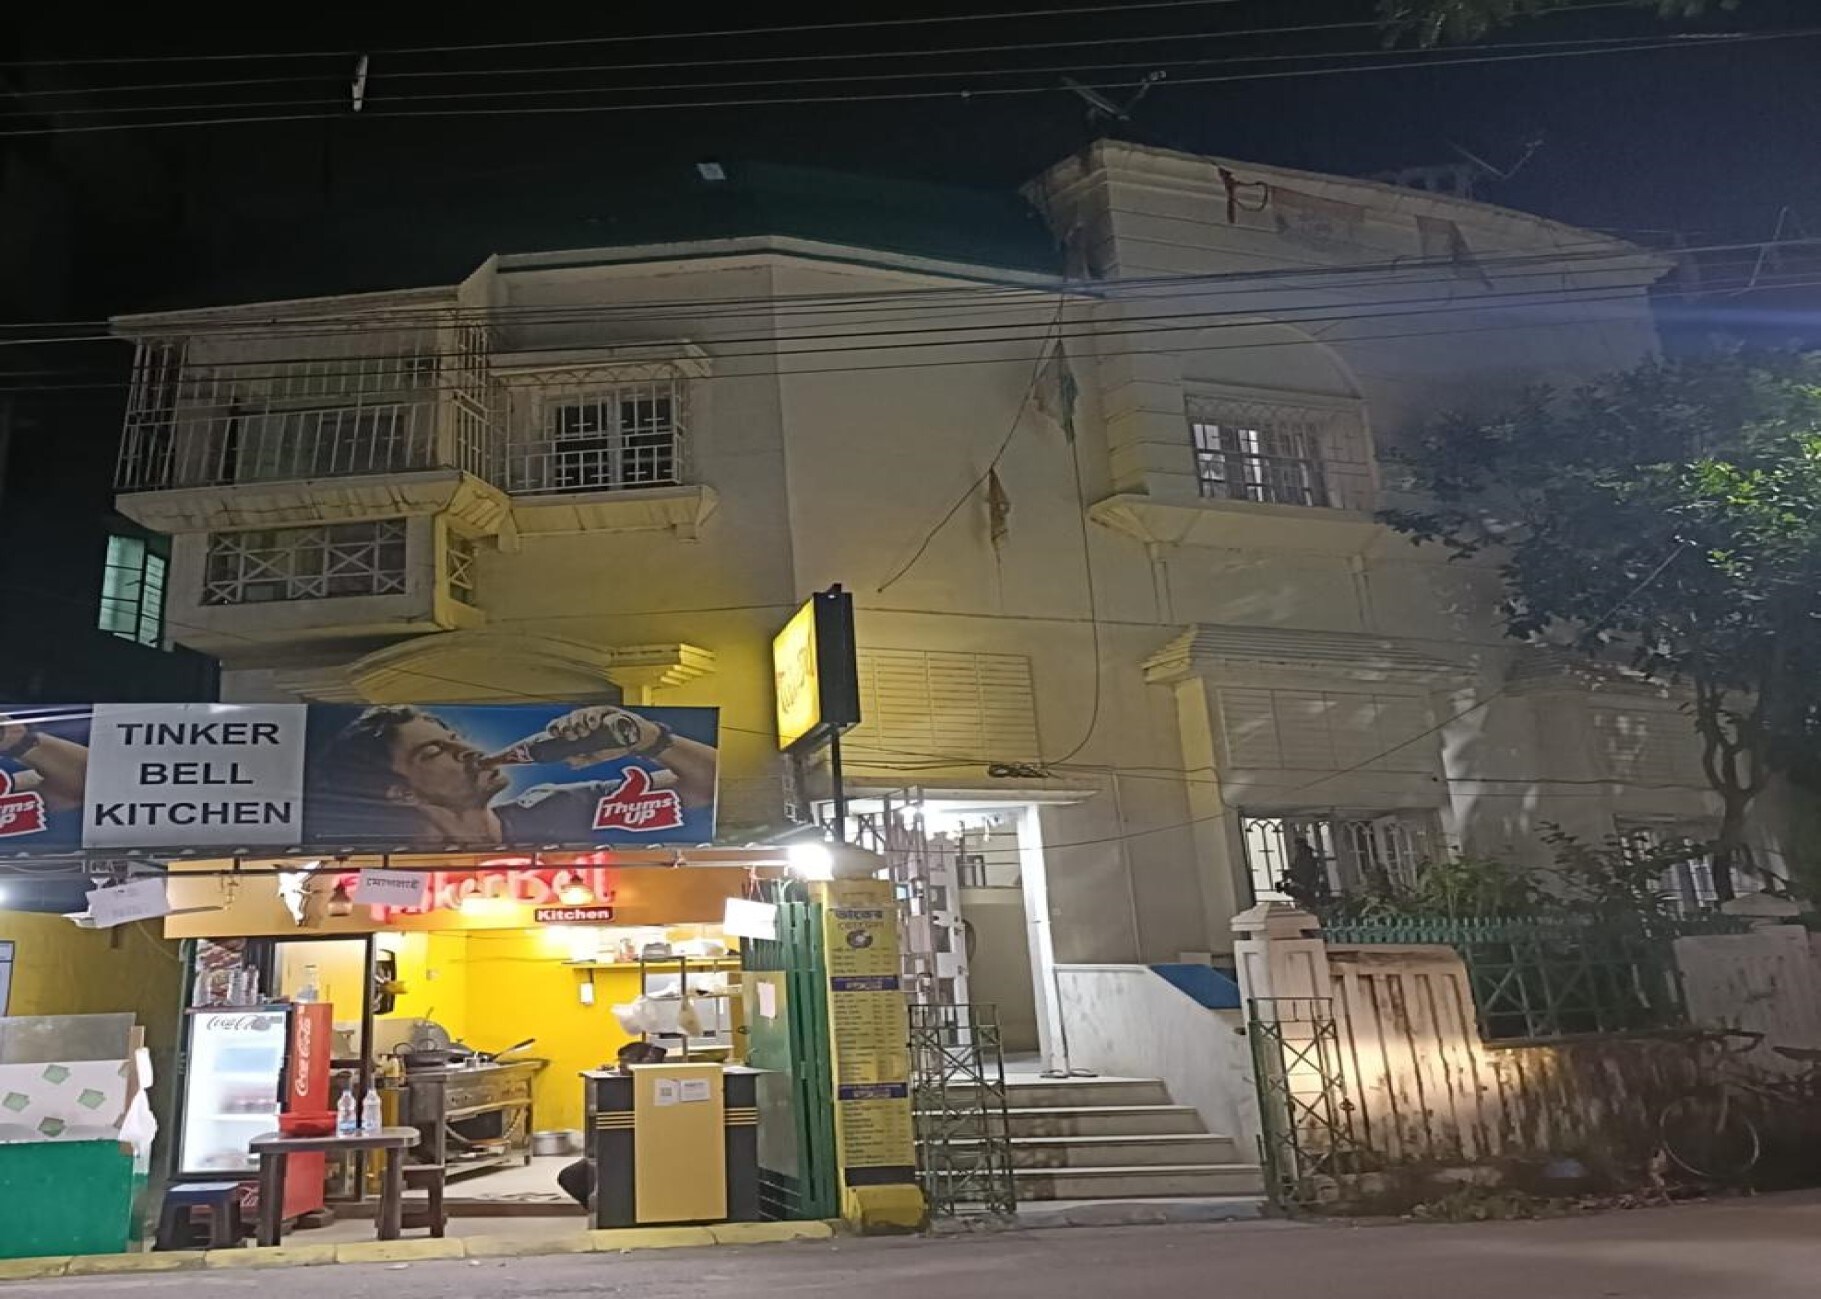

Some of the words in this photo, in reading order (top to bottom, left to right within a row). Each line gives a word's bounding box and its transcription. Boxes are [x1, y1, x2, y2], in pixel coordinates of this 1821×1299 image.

[117, 723, 280, 745] TINKER
[139, 762, 254, 785] BELL
[95, 802, 291, 826] KITCHEN
[603, 798, 673, 818] Thums
[537, 909, 610, 921] Kitchen
